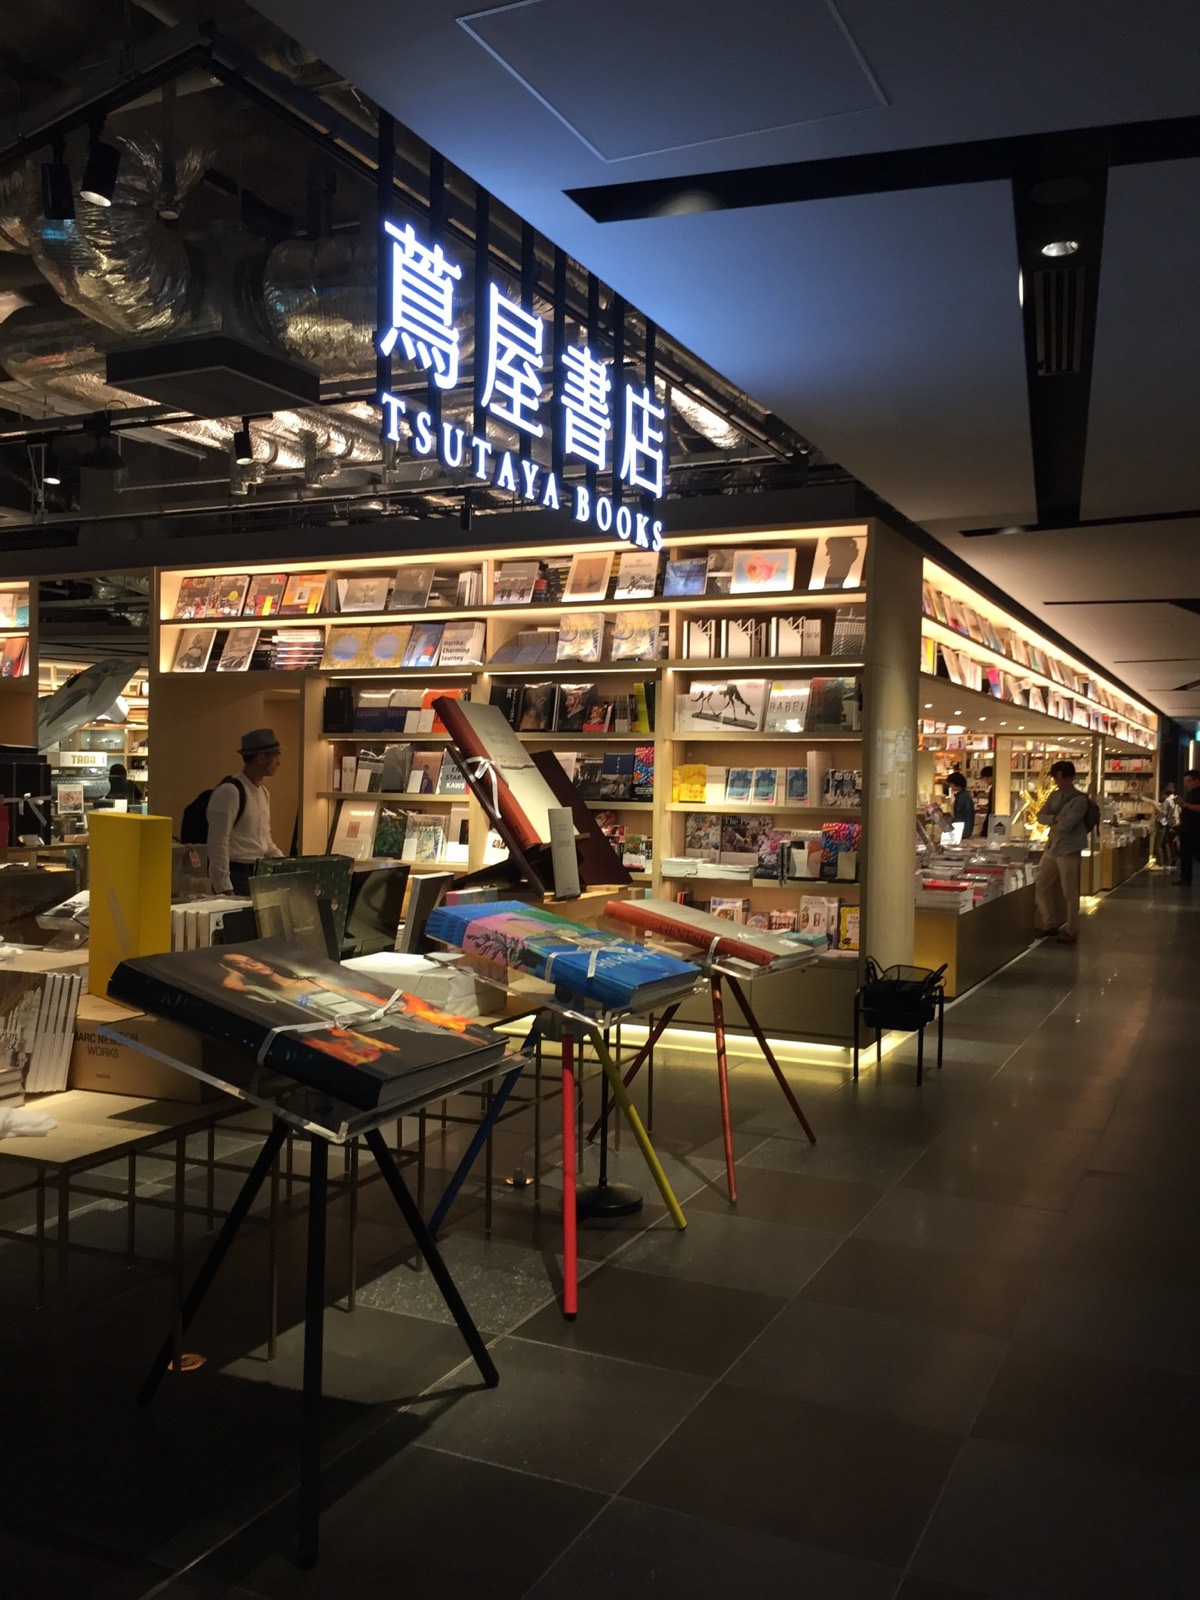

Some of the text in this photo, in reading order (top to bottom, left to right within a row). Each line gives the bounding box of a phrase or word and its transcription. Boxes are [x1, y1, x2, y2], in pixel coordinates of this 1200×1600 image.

[380, 220, 666, 499] 蔦屋書店
[381, 392, 664, 552] TSUTAYA BOOKS
[769, 701, 807, 713] BABEL
[87, 1045, 120, 1059] WORKS
